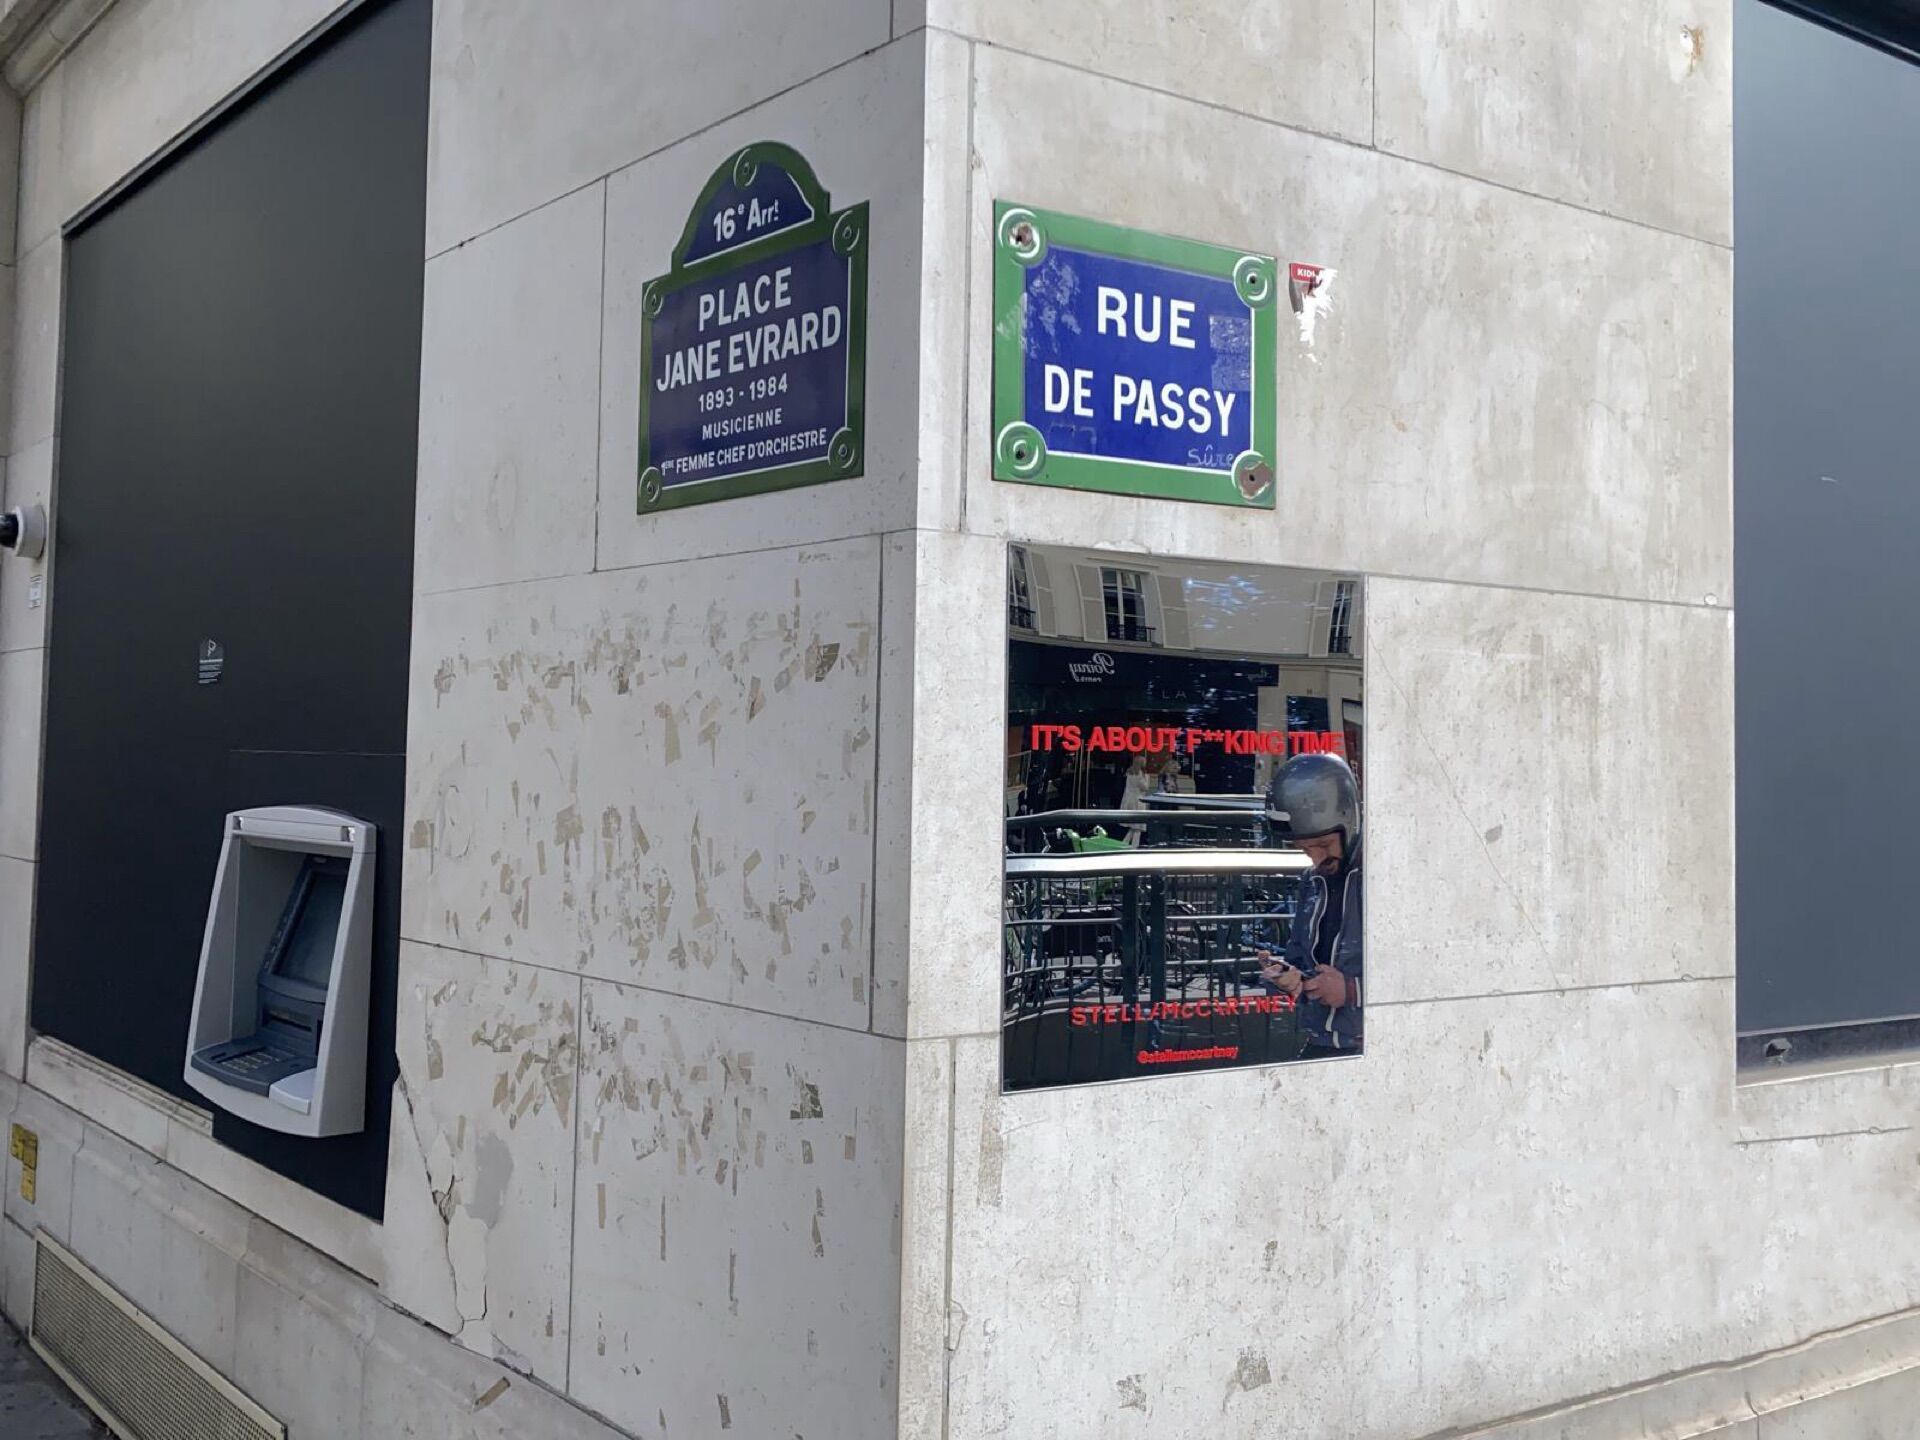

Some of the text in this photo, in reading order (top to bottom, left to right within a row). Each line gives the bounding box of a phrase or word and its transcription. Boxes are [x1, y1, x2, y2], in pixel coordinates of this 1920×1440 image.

[699, 266, 792, 332] PLACE
[1098, 286, 1196, 349] RUE
[656, 305, 841, 392] JANE EVRARD
[698, 386, 734, 413] 1893
[749, 372, 788, 401] 1984
[1044, 364, 1236, 437] DE PASSY
[676, 451, 715, 475] FEMME
[717, 444, 746, 467] CHEF
[749, 427, 827, 460] D'ORCHESTRE
[702, 407, 782, 440] MUSICIENNE
[1031, 725, 1082, 751] IT'S
[1088, 726, 1181, 753] ABOUT
[1288, 730, 1345, 755] TIME
